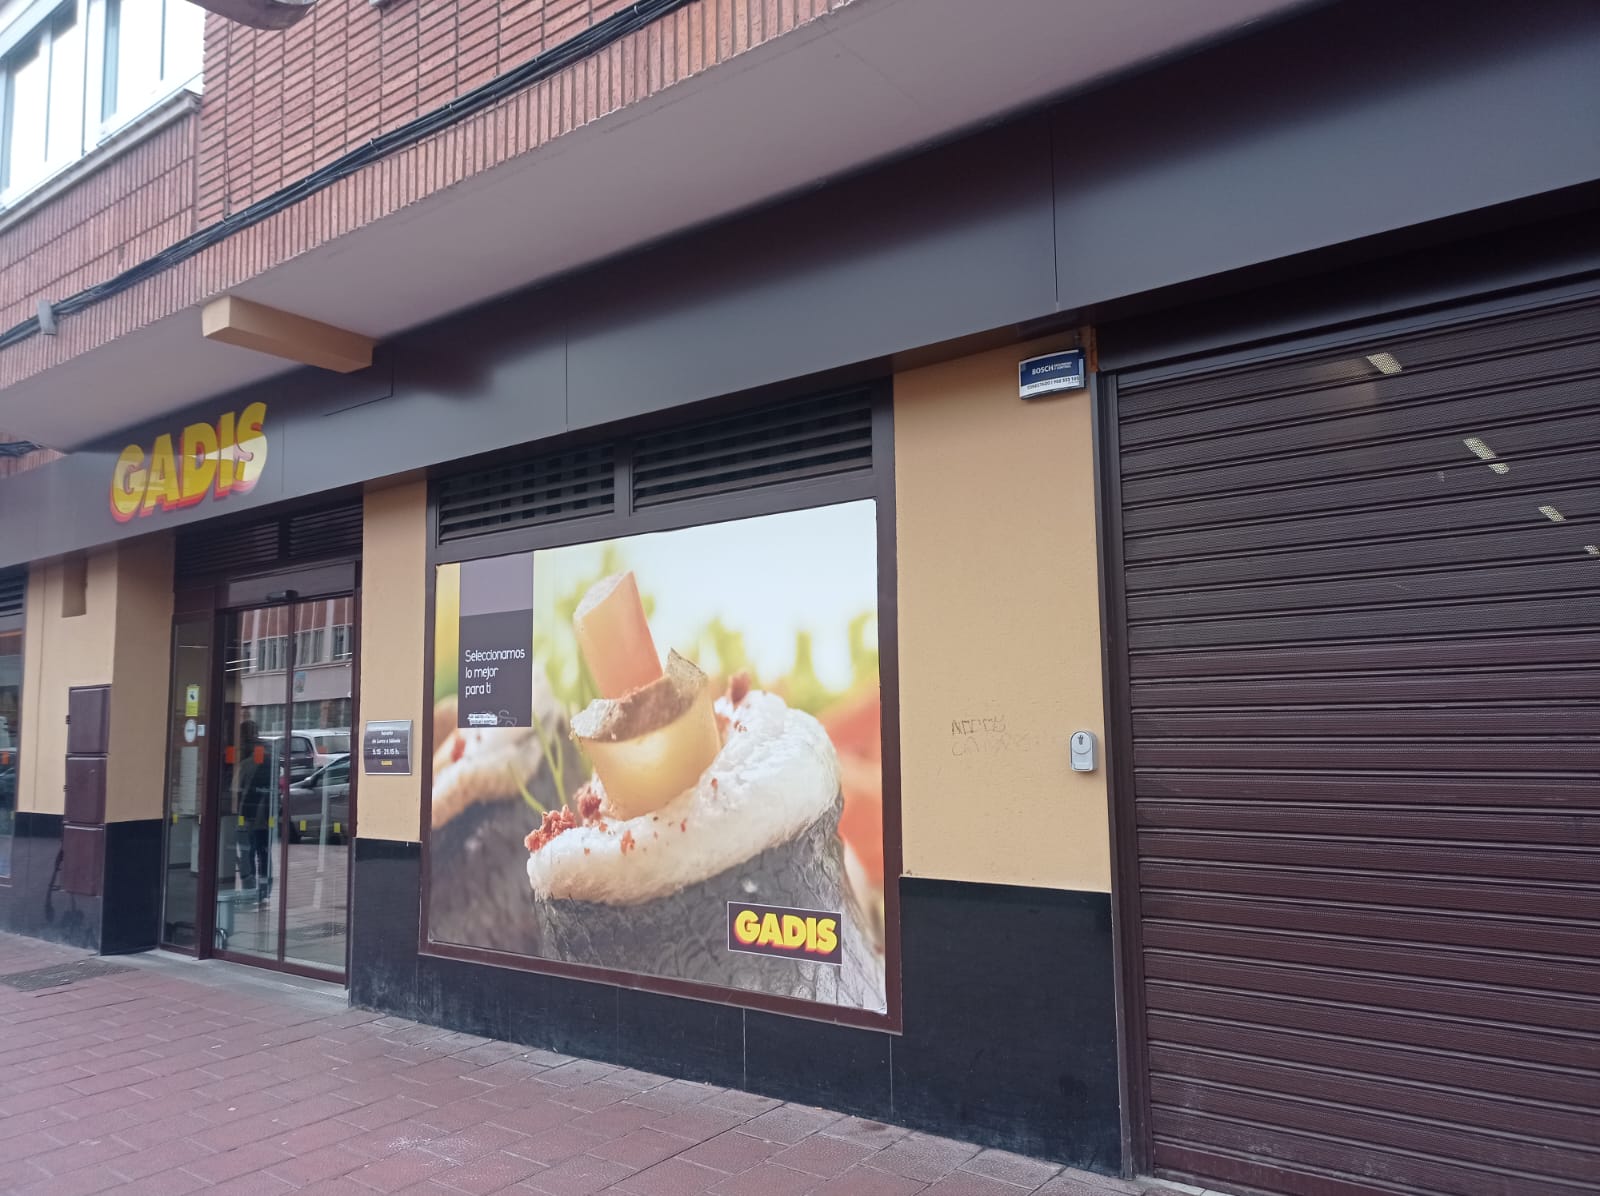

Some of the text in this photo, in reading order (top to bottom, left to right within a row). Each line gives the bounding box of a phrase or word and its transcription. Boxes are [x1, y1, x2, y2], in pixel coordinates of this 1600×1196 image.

[1031, 365, 1054, 375] BOSCH
[110, 402, 267, 523] GADIS
[465, 649, 526, 663] Seleccionamos
[465, 666, 499, 681] lo mejor
[465, 682, 492, 699] para ti
[734, 910, 838, 955] GADIS
